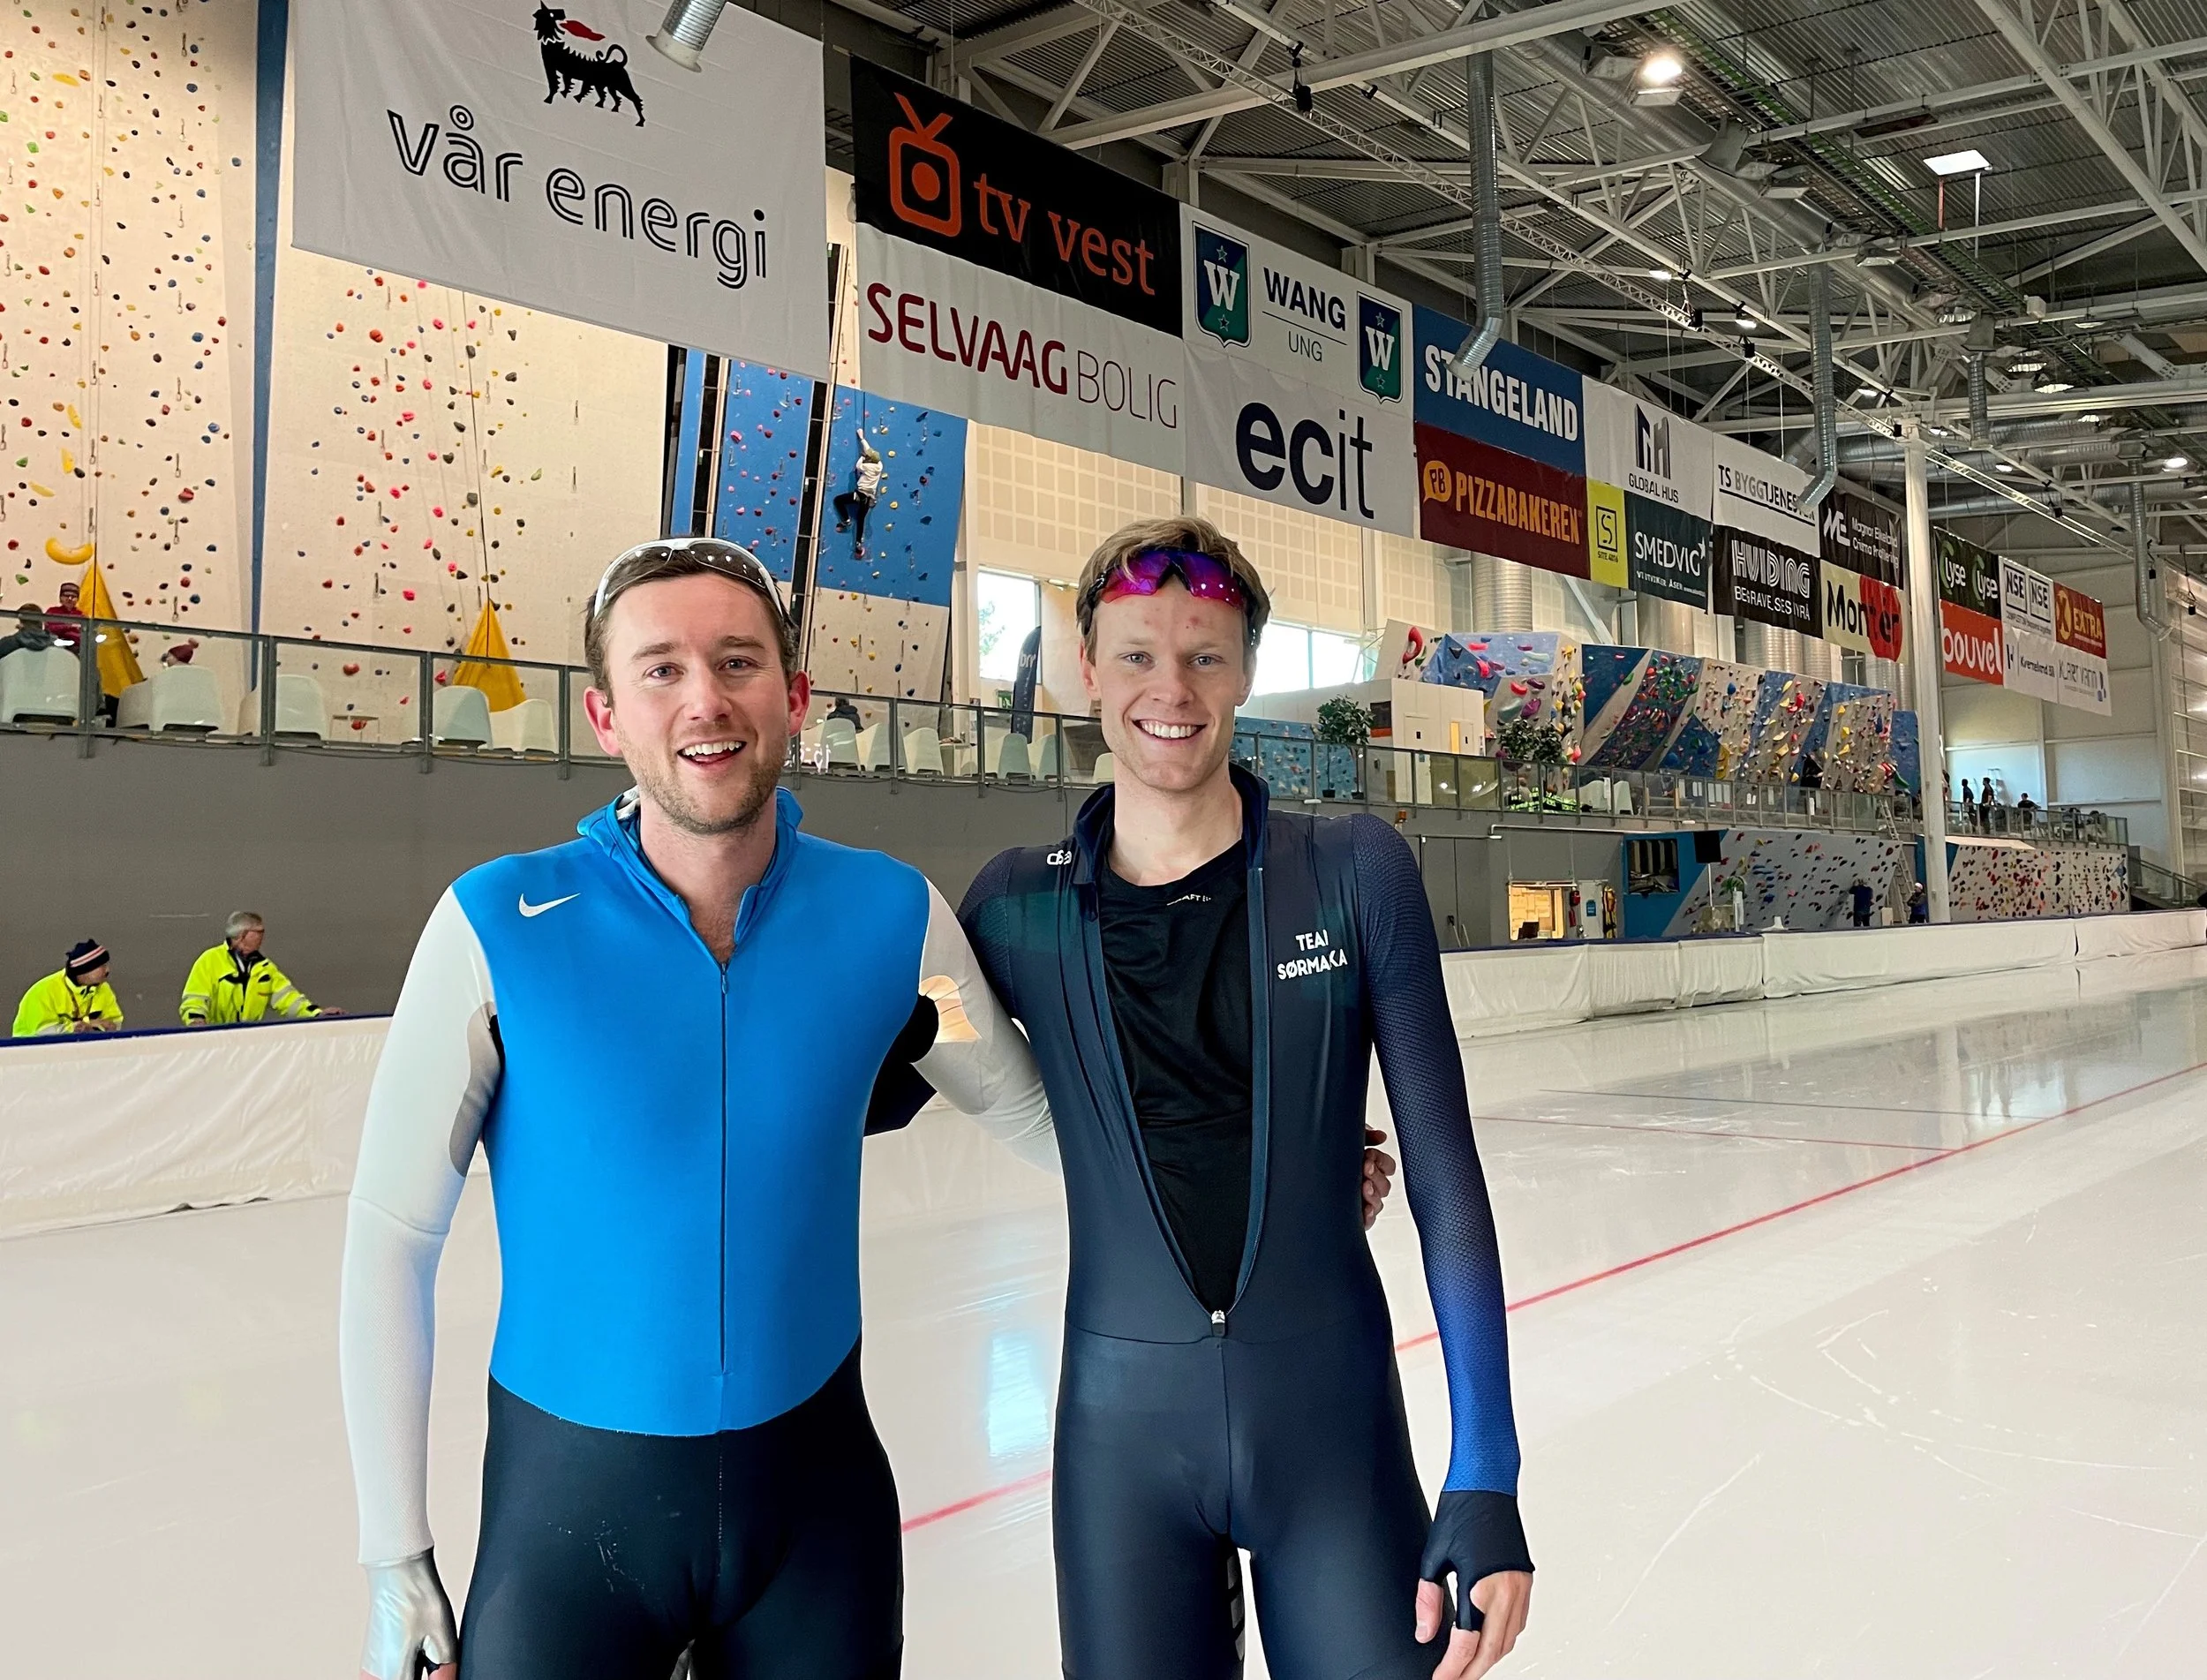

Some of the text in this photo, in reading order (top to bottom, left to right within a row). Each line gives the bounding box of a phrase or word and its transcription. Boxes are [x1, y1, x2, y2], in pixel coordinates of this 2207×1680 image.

[387, 105, 767, 290] vår energi
[974, 173, 1156, 297] tv vest
[1263, 267, 1346, 332] WANG
[866, 282, 1178, 430] SELVAAG BOLIG
[1288, 330, 1322, 363] UNG
[1236, 401, 1375, 520] ecit
[1629, 473, 1679, 503] GLOBAL HUS
[1718, 464, 1815, 521] TS BYGGTJENES
[1456, 471, 1580, 545] PIZZABAKEREN
[1635, 531, 1700, 576] SMEDVIG
[2073, 607, 2103, 641] EXTRA
